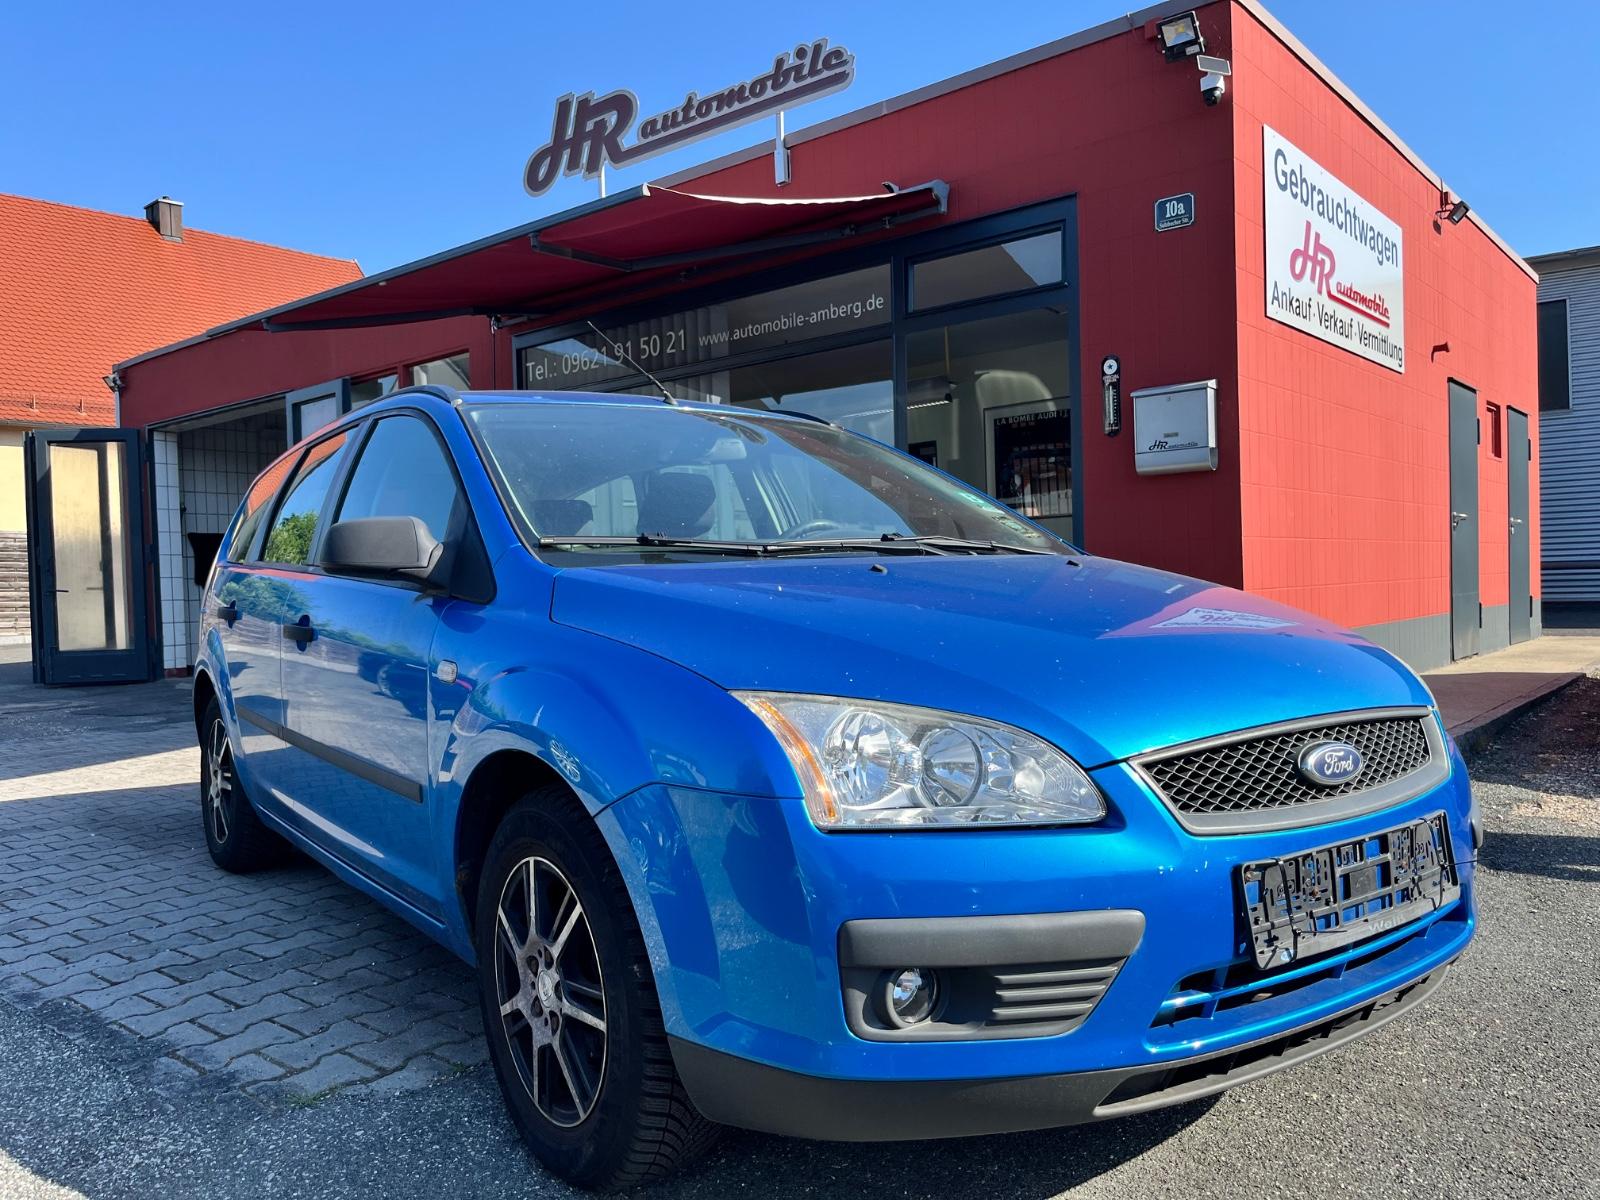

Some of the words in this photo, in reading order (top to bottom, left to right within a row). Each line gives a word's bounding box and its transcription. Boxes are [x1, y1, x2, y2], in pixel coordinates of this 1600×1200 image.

[525, 92, 638, 196] HR
[640, 40, 852, 142] automobile
[1165, 200, 1186, 218] 10a
[1273, 148, 1399, 268] Gebrauchtwagen
[1289, 220, 1336, 298] HR
[1336, 279, 1390, 321] automobile
[698, 294, 885, 347] www.automobile-amberg.de
[1271, 280, 1312, 321] Ankauf
[1317, 301, 1353, 342] Verkauf
[1358, 323, 1403, 368] Vermittlung
[526, 357, 557, 382] Tel.:
[562, 345, 608, 376] 09621
[614, 340, 632, 365] 91
[640, 334, 661, 360] 50
[666, 329, 686, 353] 21
[1148, 439, 1169, 451] HR
[1324, 751, 1354, 775] Ford
